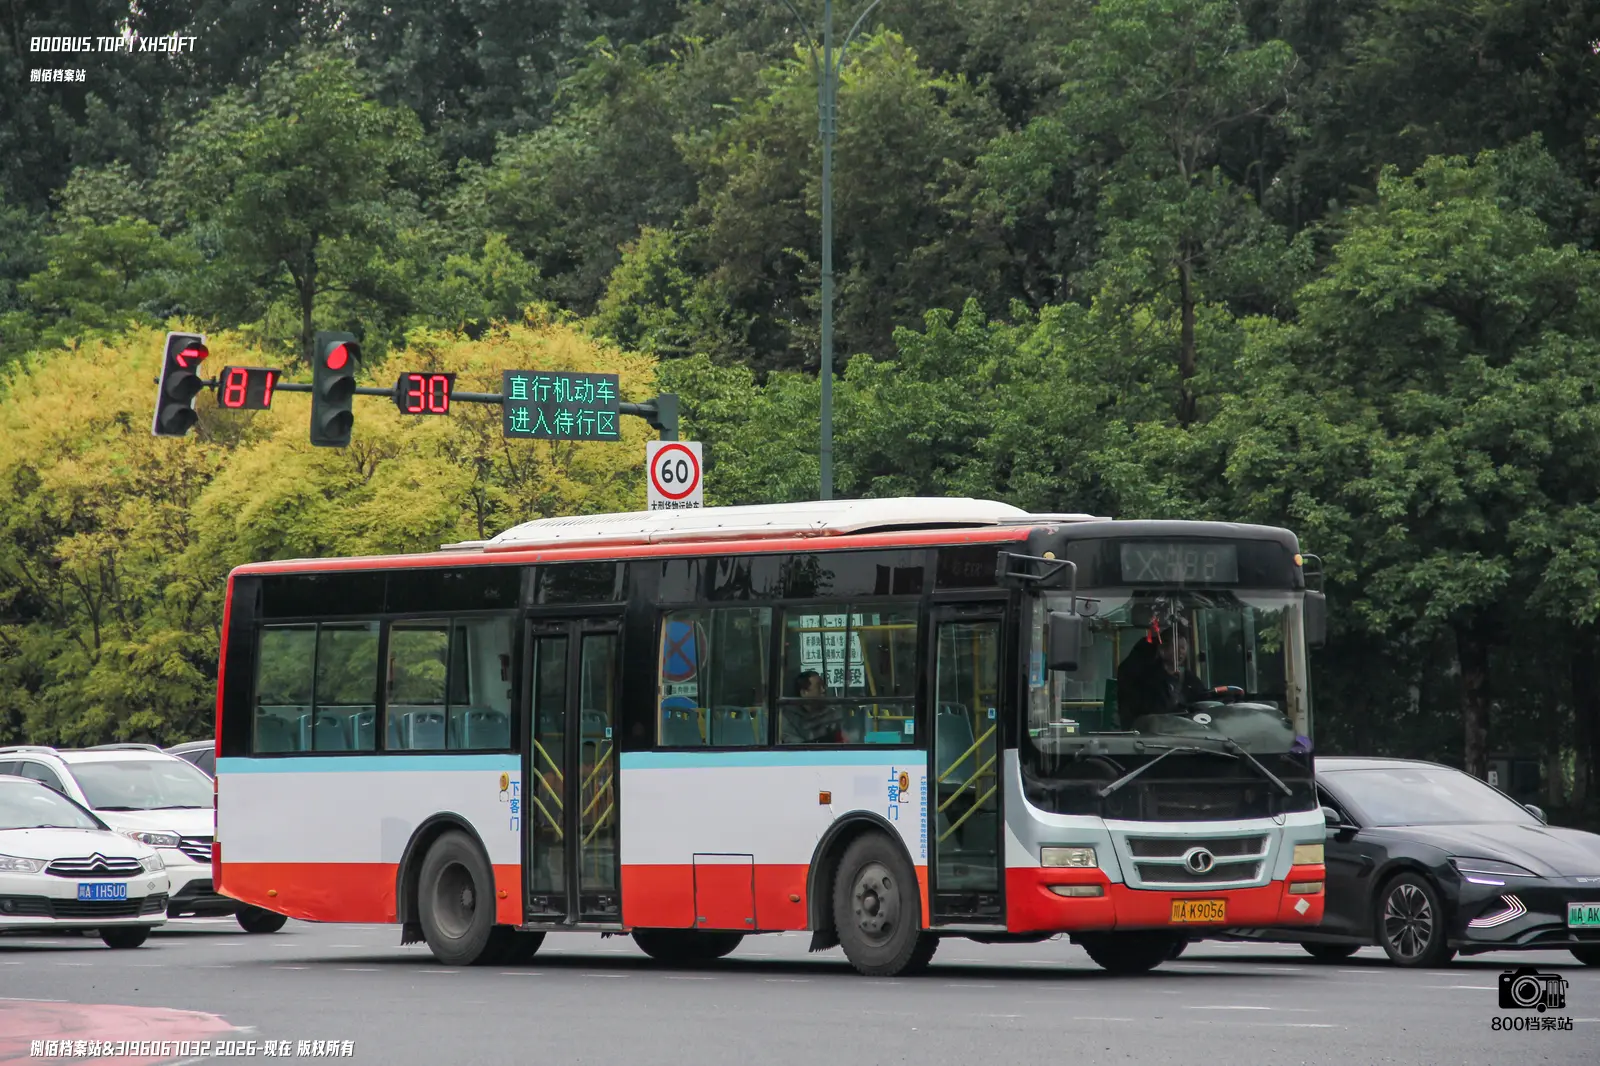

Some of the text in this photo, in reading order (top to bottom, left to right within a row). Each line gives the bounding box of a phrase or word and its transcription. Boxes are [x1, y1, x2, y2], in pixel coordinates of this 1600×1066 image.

[224, 368, 273, 407] 81
[408, 375, 448, 413] 30
[509, 375, 616, 404] 直行机动车
[509, 407, 617, 436] 进入待行区
[661, 459, 689, 484] 60
[510, 781, 520, 831] 下客门
[887, 766, 899, 820] 上客门
